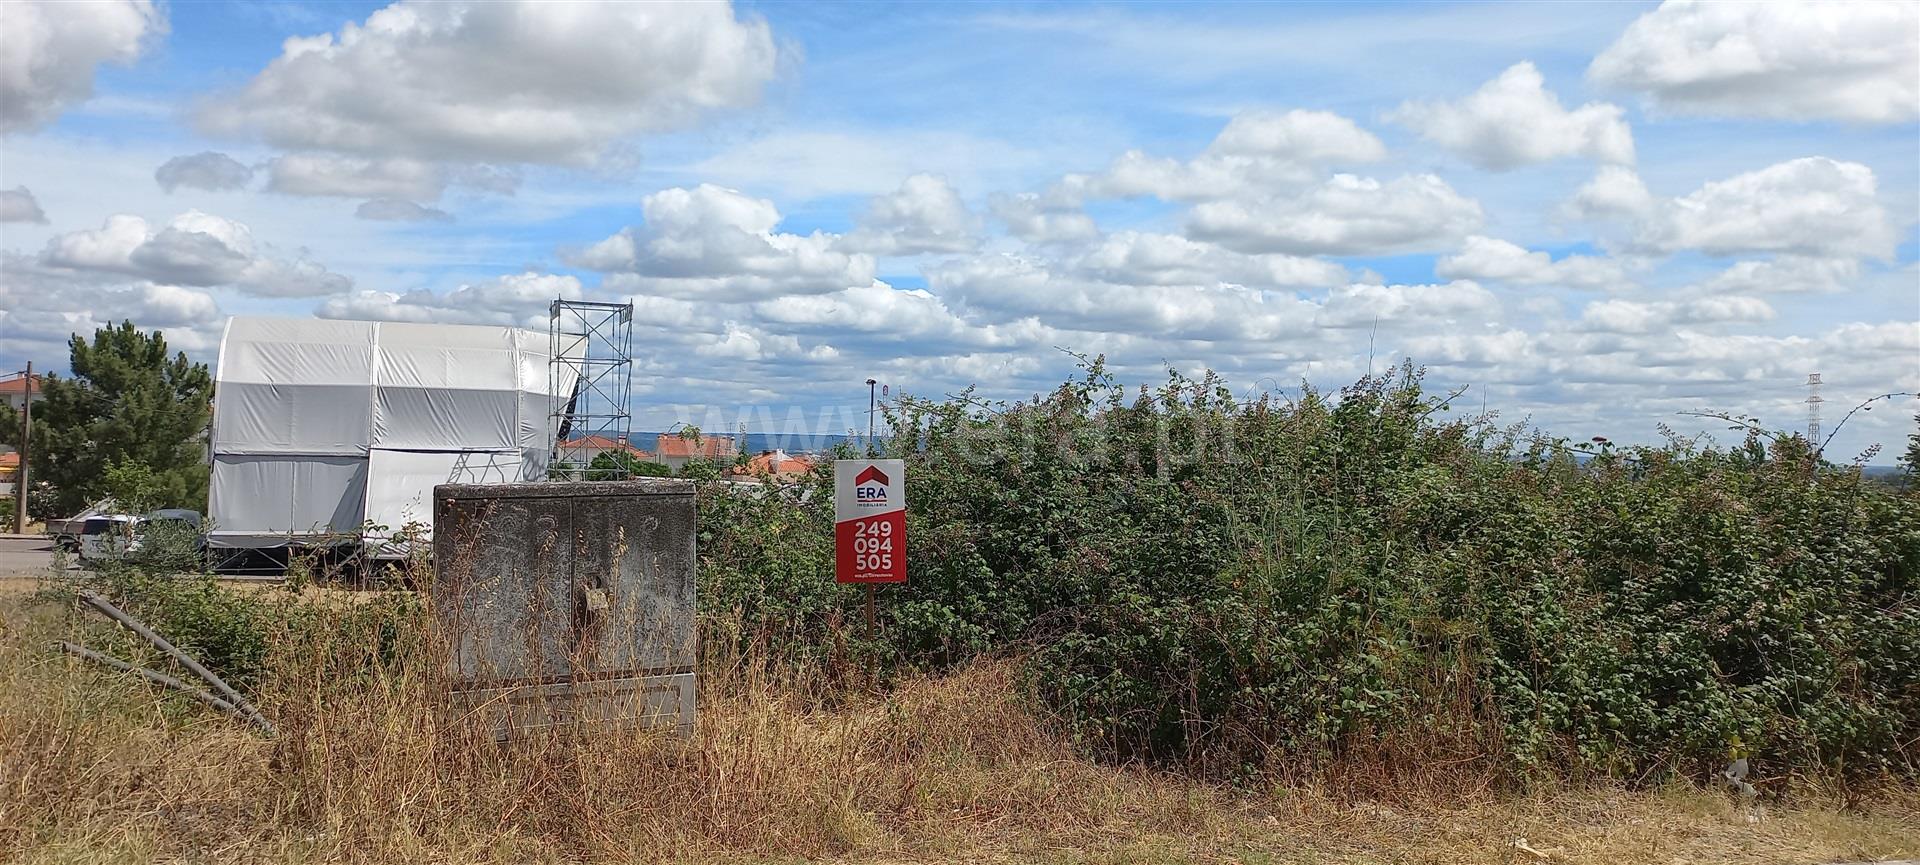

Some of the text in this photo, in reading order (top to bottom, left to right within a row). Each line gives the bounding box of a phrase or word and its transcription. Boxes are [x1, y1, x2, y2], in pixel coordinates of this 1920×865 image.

[857, 487, 887, 498] ERA
[855, 521, 892, 537] 249
[854, 538, 893, 554] 094
[856, 554, 892, 570] 505
